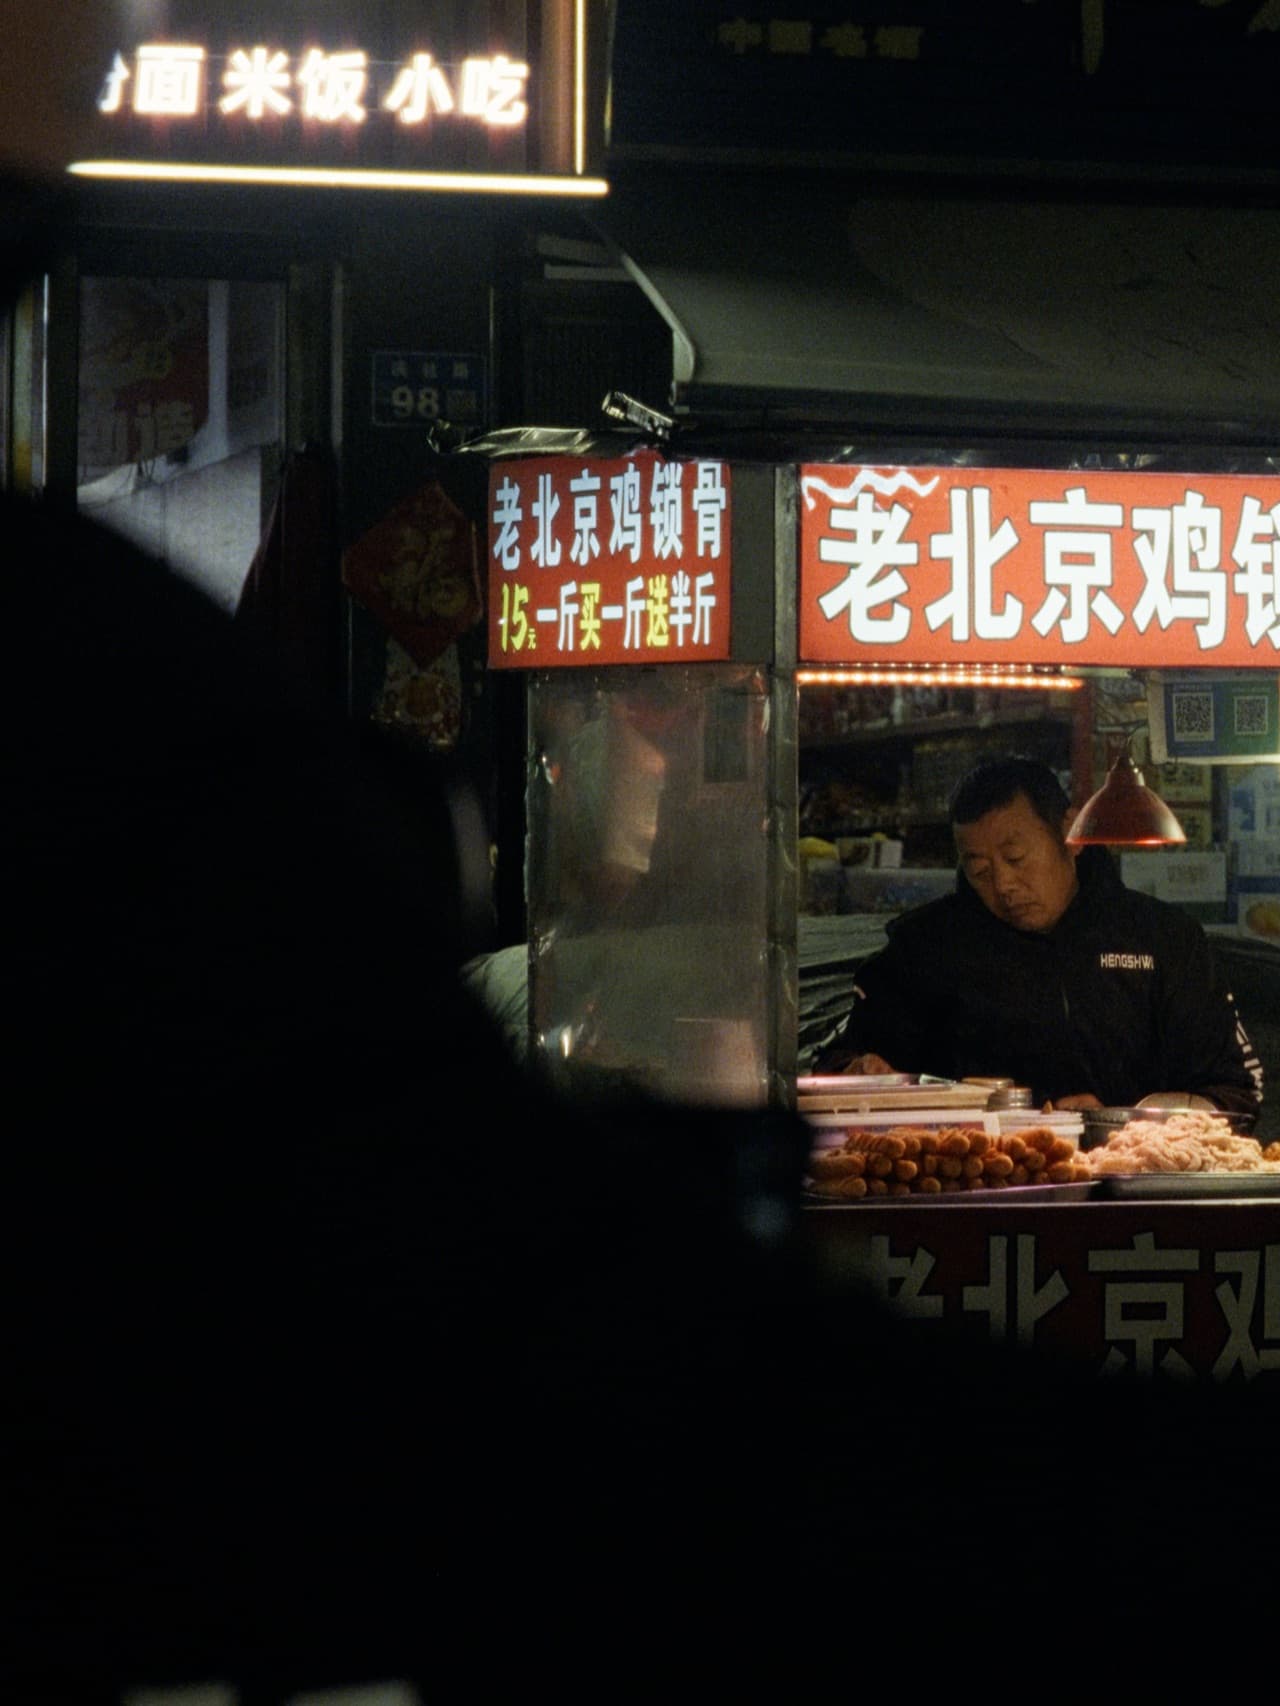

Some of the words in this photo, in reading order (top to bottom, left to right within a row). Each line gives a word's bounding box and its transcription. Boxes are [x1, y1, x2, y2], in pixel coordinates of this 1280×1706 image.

[219, 46, 367, 124] 米饭
[385, 52, 529, 126] 小吃
[390, 383, 441, 420] 98
[493, 461, 727, 571] 老北京鸡锁骨
